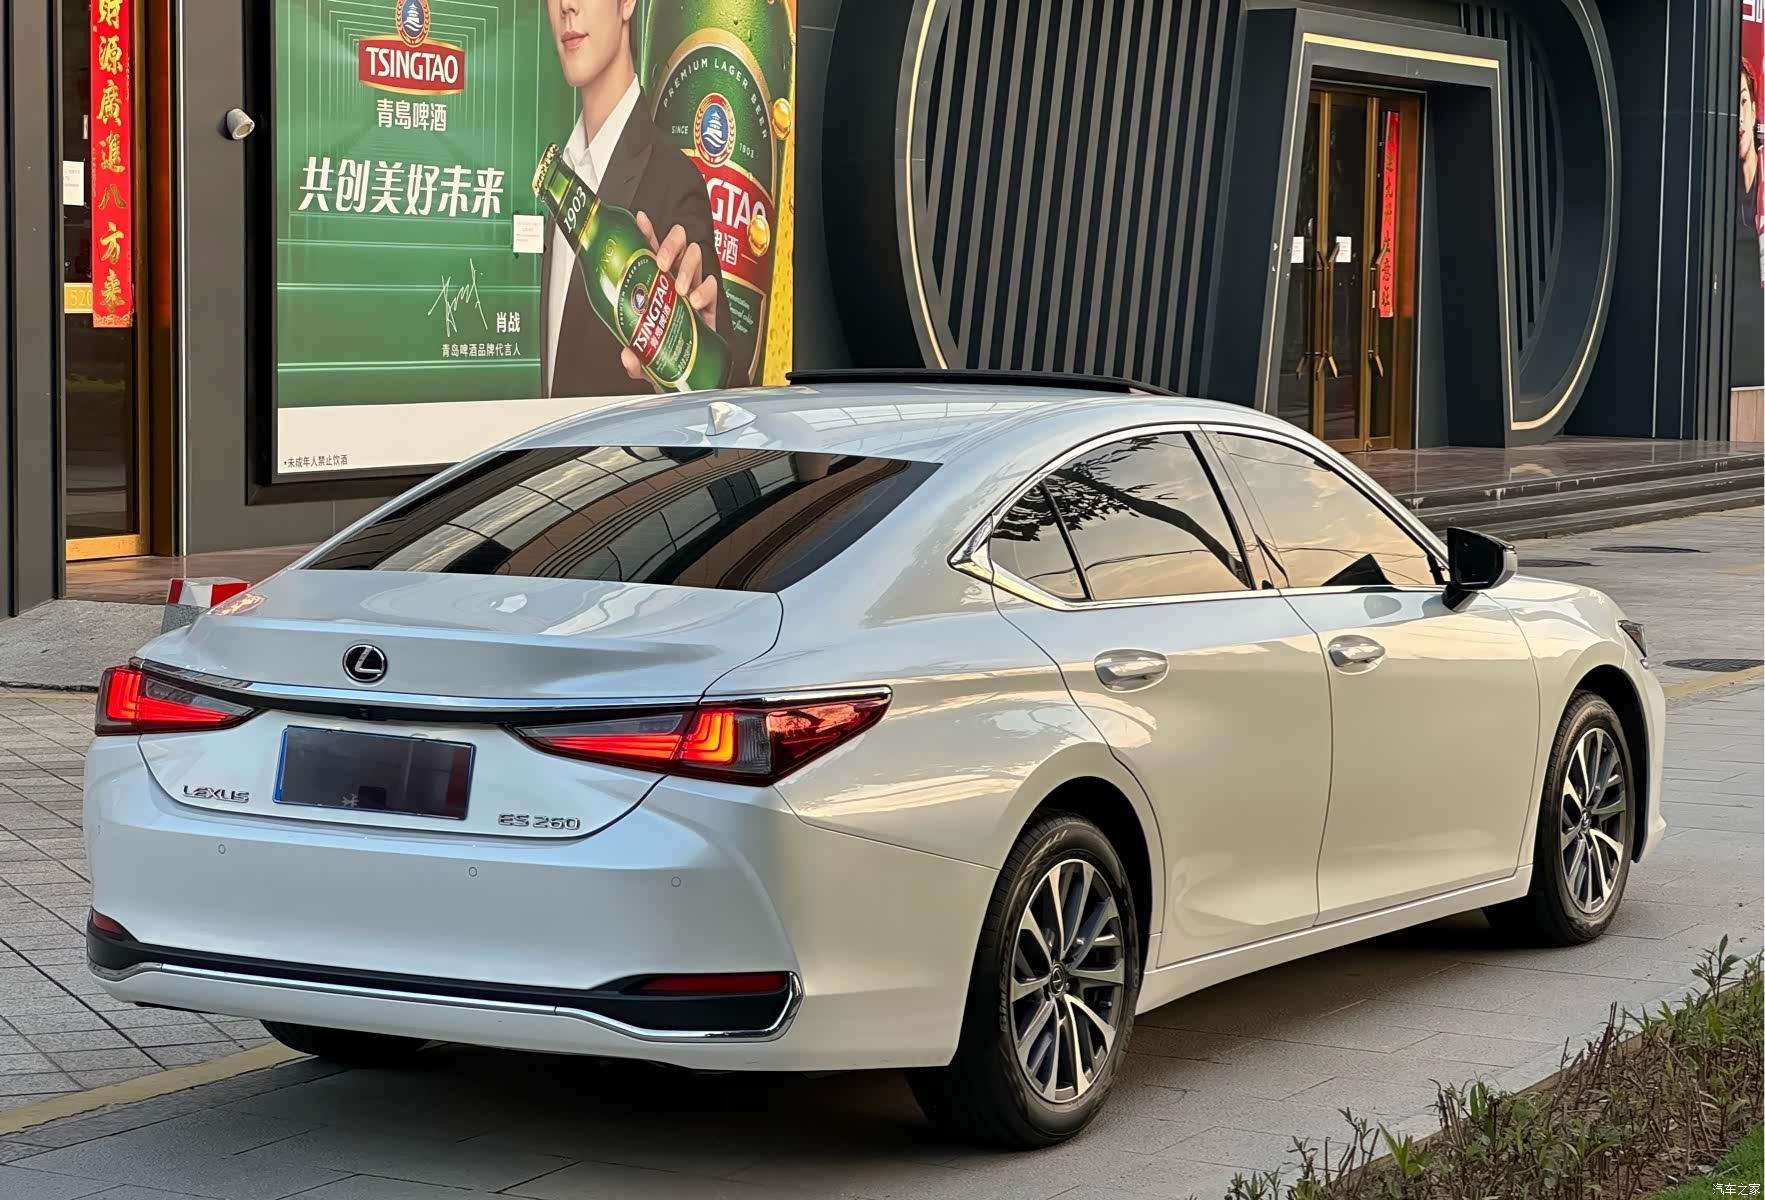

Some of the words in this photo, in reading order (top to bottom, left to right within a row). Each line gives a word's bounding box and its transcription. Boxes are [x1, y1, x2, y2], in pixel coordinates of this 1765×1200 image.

[365, 46, 459, 84] TSINGTAO
[663, 58, 708, 108] PREMIUM
[714, 58, 748, 89] LAGER
[750, 93, 768, 139] BEER
[671, 125, 689, 135] SINCE
[298, 156, 505, 218] 共创美好未来
[564, 185, 587, 234] 1903
[496, 311, 521, 333] 肖战
[632, 274, 670, 353] TSINGTAO
[442, 342, 521, 357] 青岛啤酒品牌代言人
[182, 784, 250, 803] LEXUS
[498, 813, 530, 827] ES
[532, 815, 581, 831] 260
